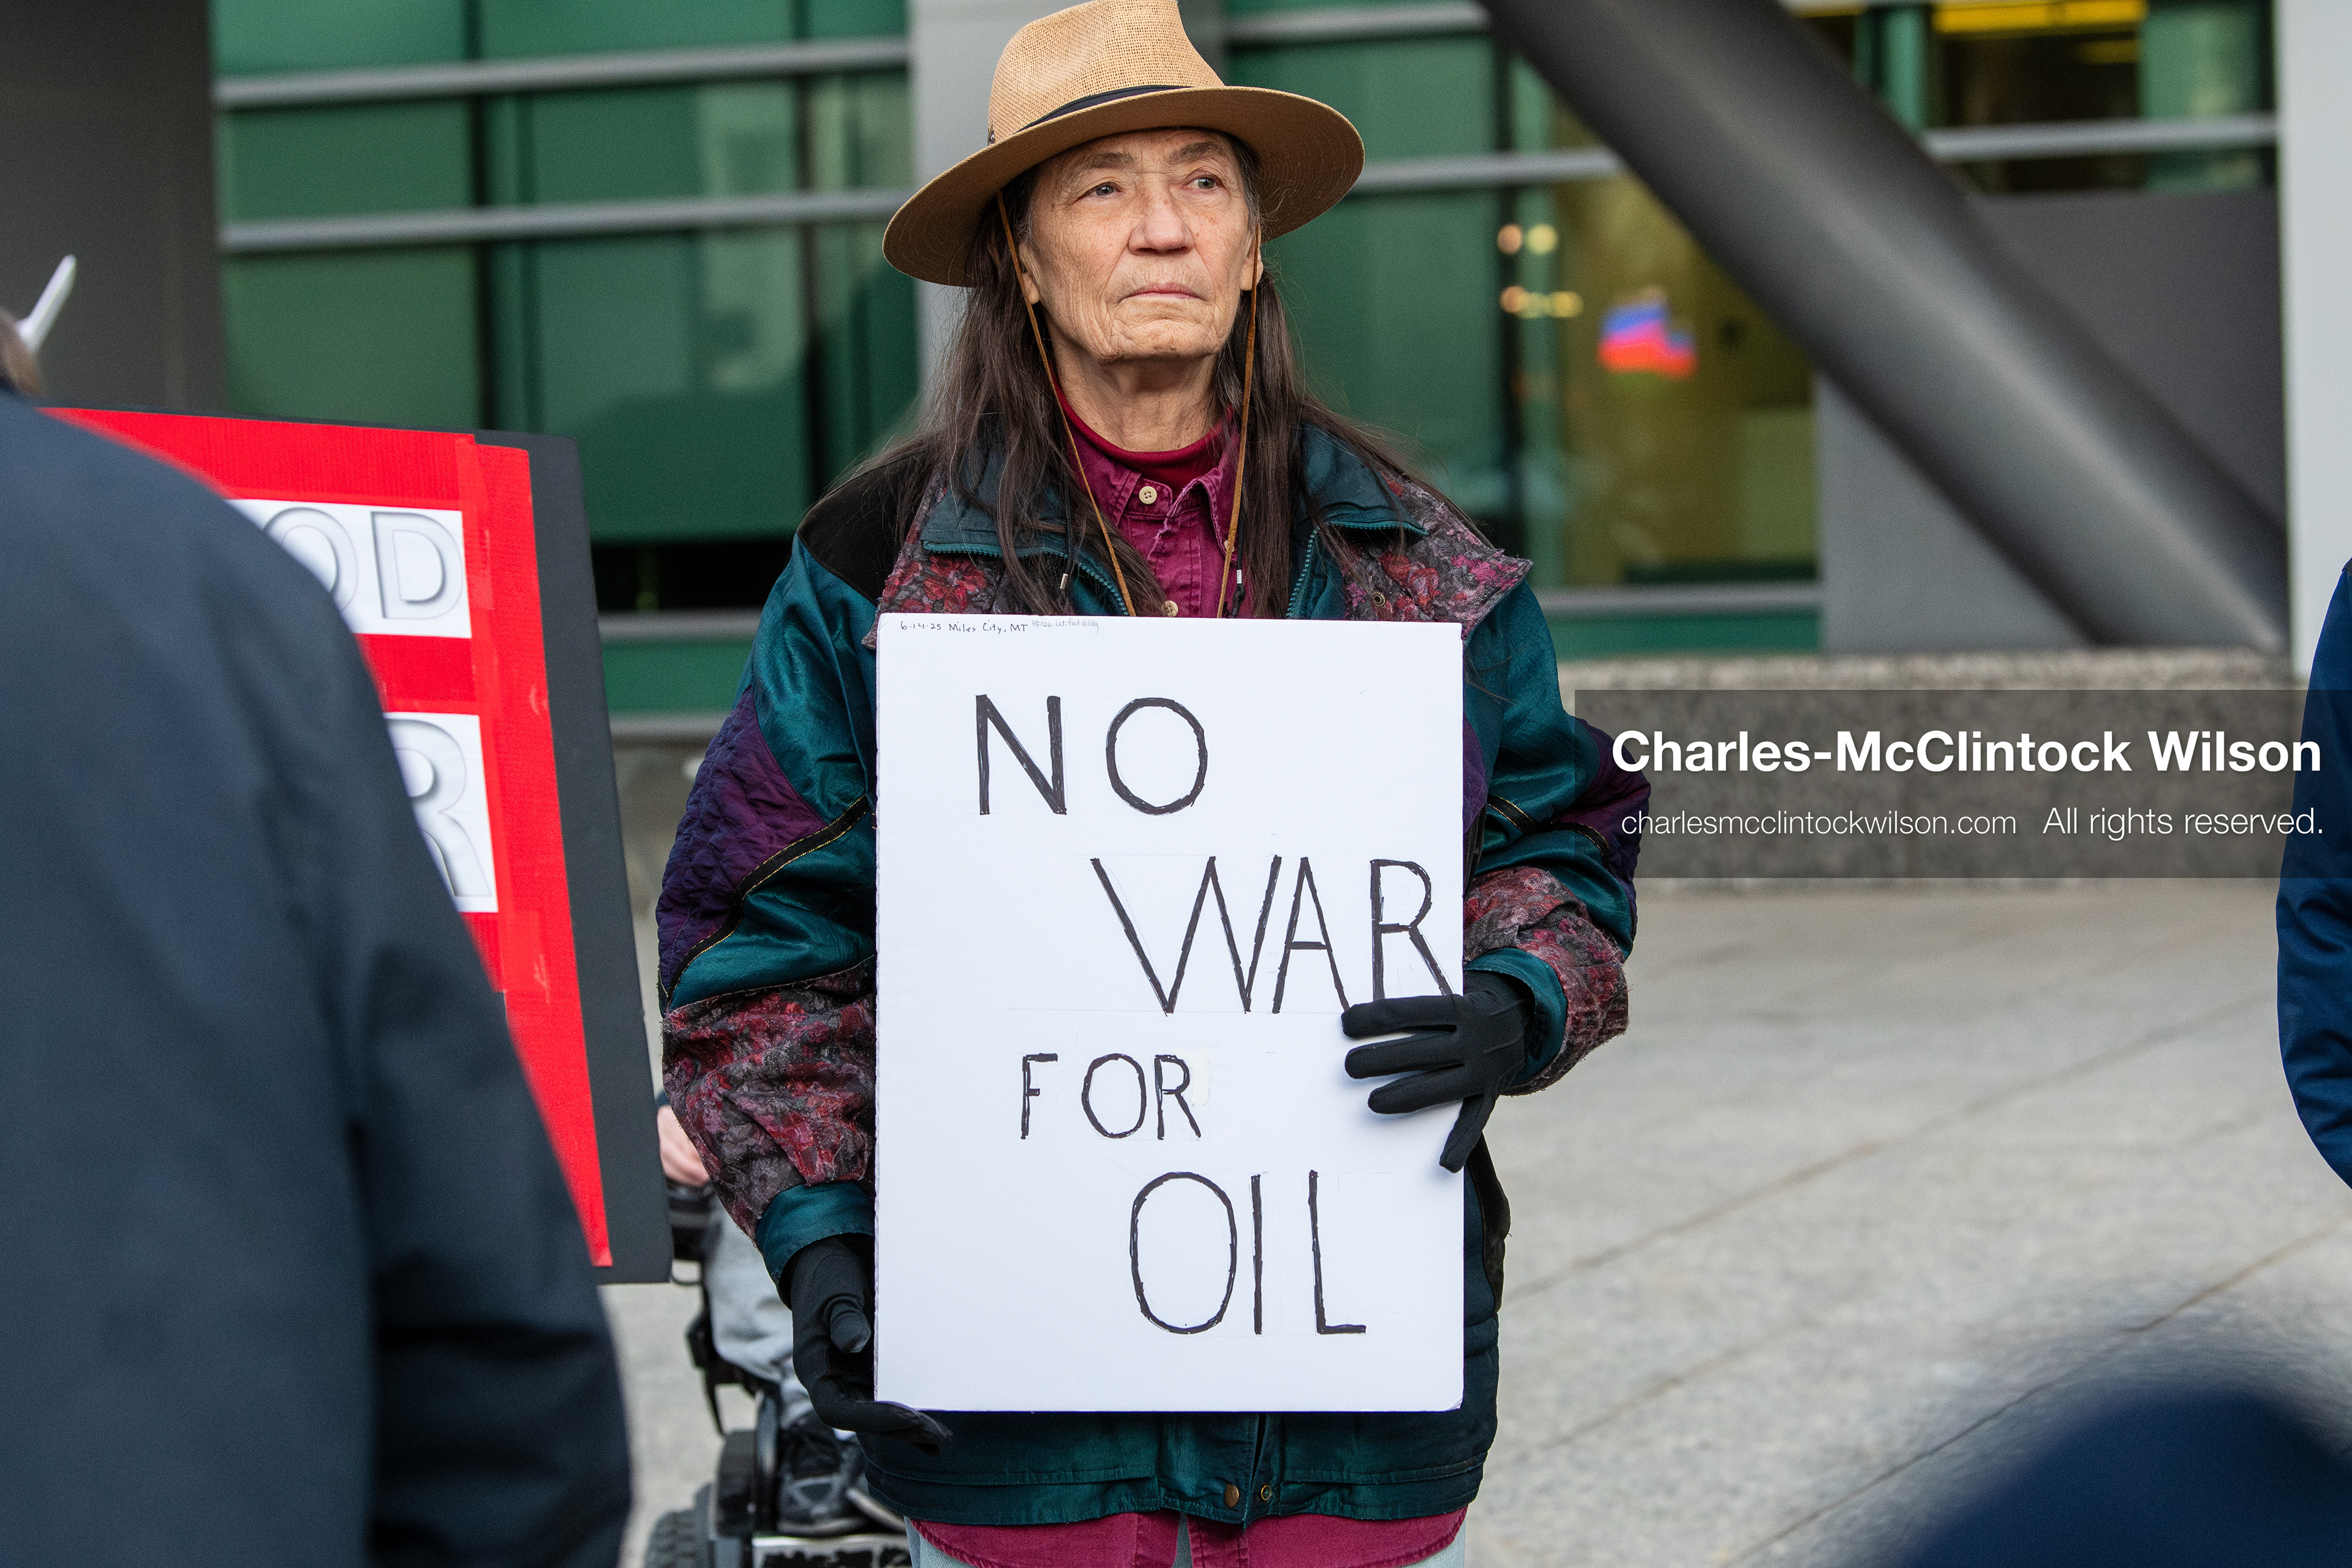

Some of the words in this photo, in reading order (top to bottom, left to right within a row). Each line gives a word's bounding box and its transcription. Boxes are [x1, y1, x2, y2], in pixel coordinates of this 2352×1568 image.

[949, 621, 976, 633] Miles
[982, 620, 1006, 635] City,
[1010, 623, 1028, 632] MT
[975, 693, 1208, 816] NO
[1090, 855, 1454, 1016] WAR
[1020, 1052, 1202, 1140] FOR
[1129, 1169, 1366, 1335] OIL
